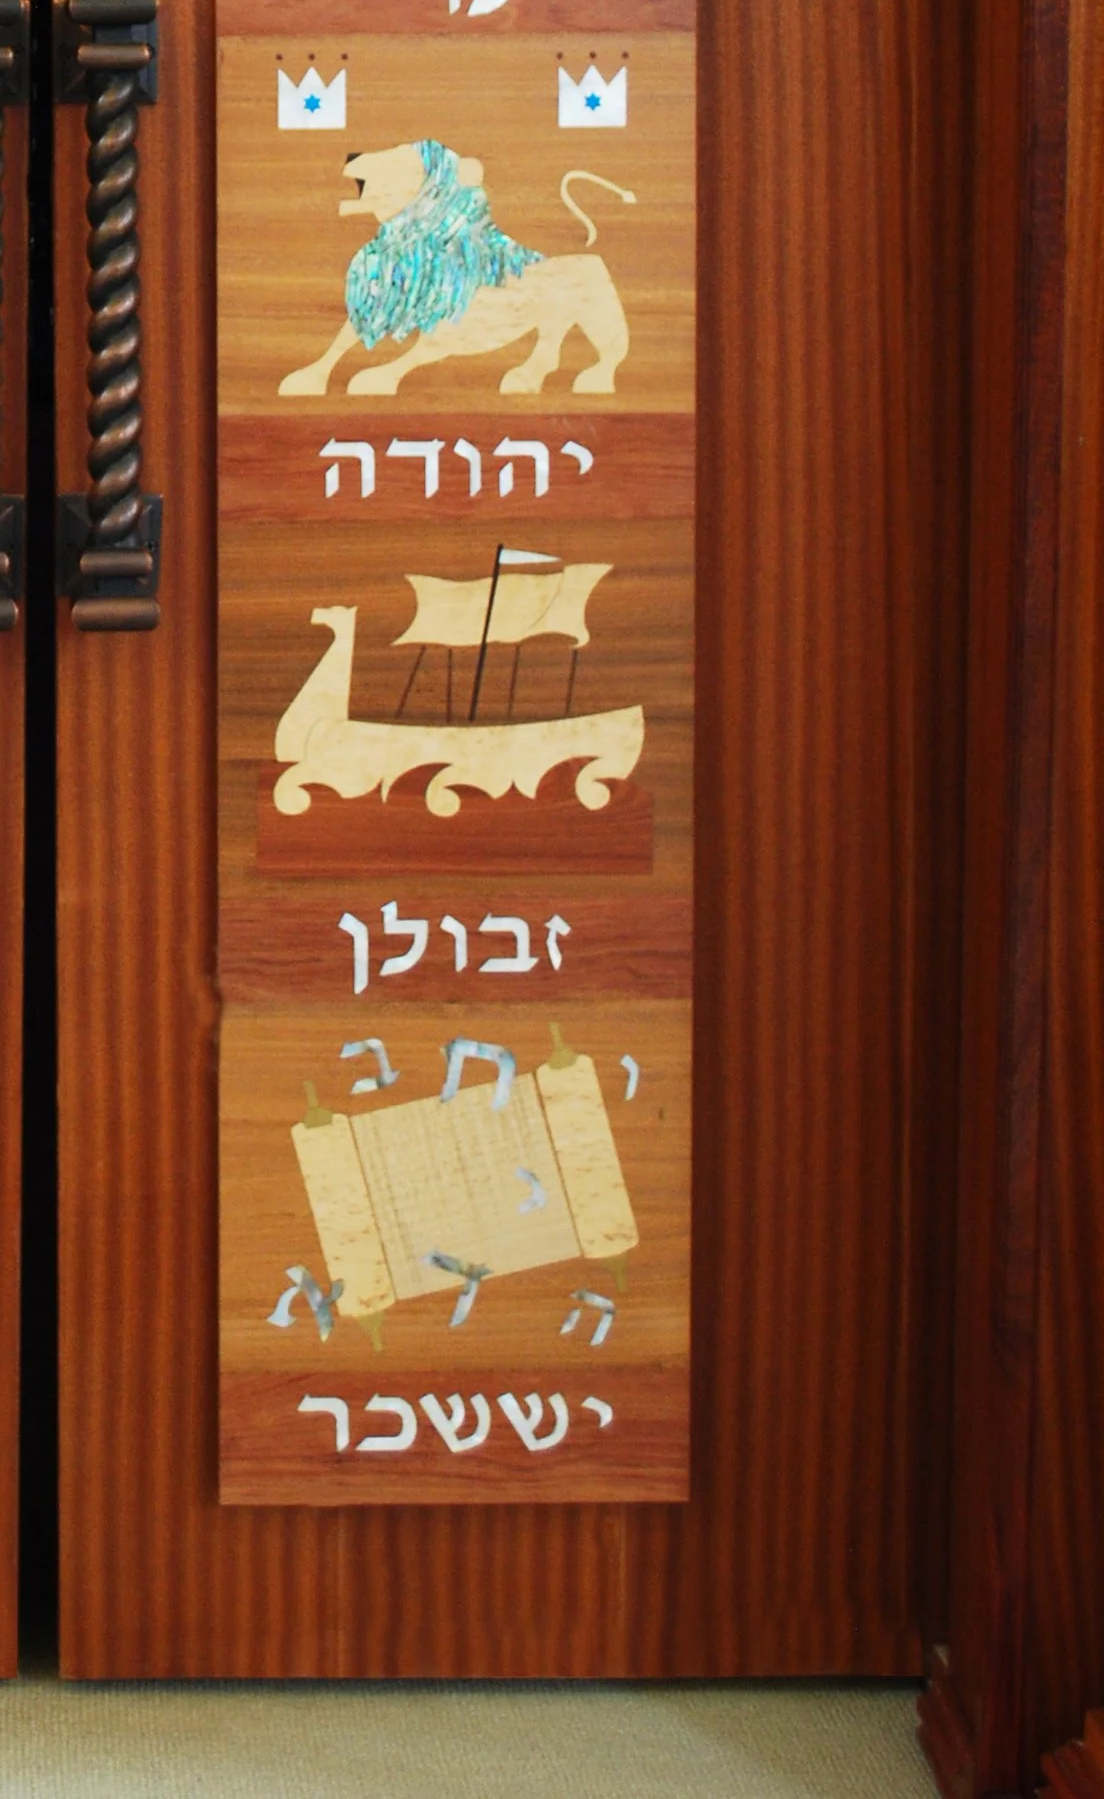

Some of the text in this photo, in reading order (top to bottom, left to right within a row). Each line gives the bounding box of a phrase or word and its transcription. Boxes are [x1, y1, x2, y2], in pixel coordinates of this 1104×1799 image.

[318, 435, 595, 499] יהודה
[337, 899, 572, 996] זבולן
[266, 1264, 345, 1343] א
[559, 1289, 616, 1347] ה
[297, 1391, 614, 1454] יששכר
